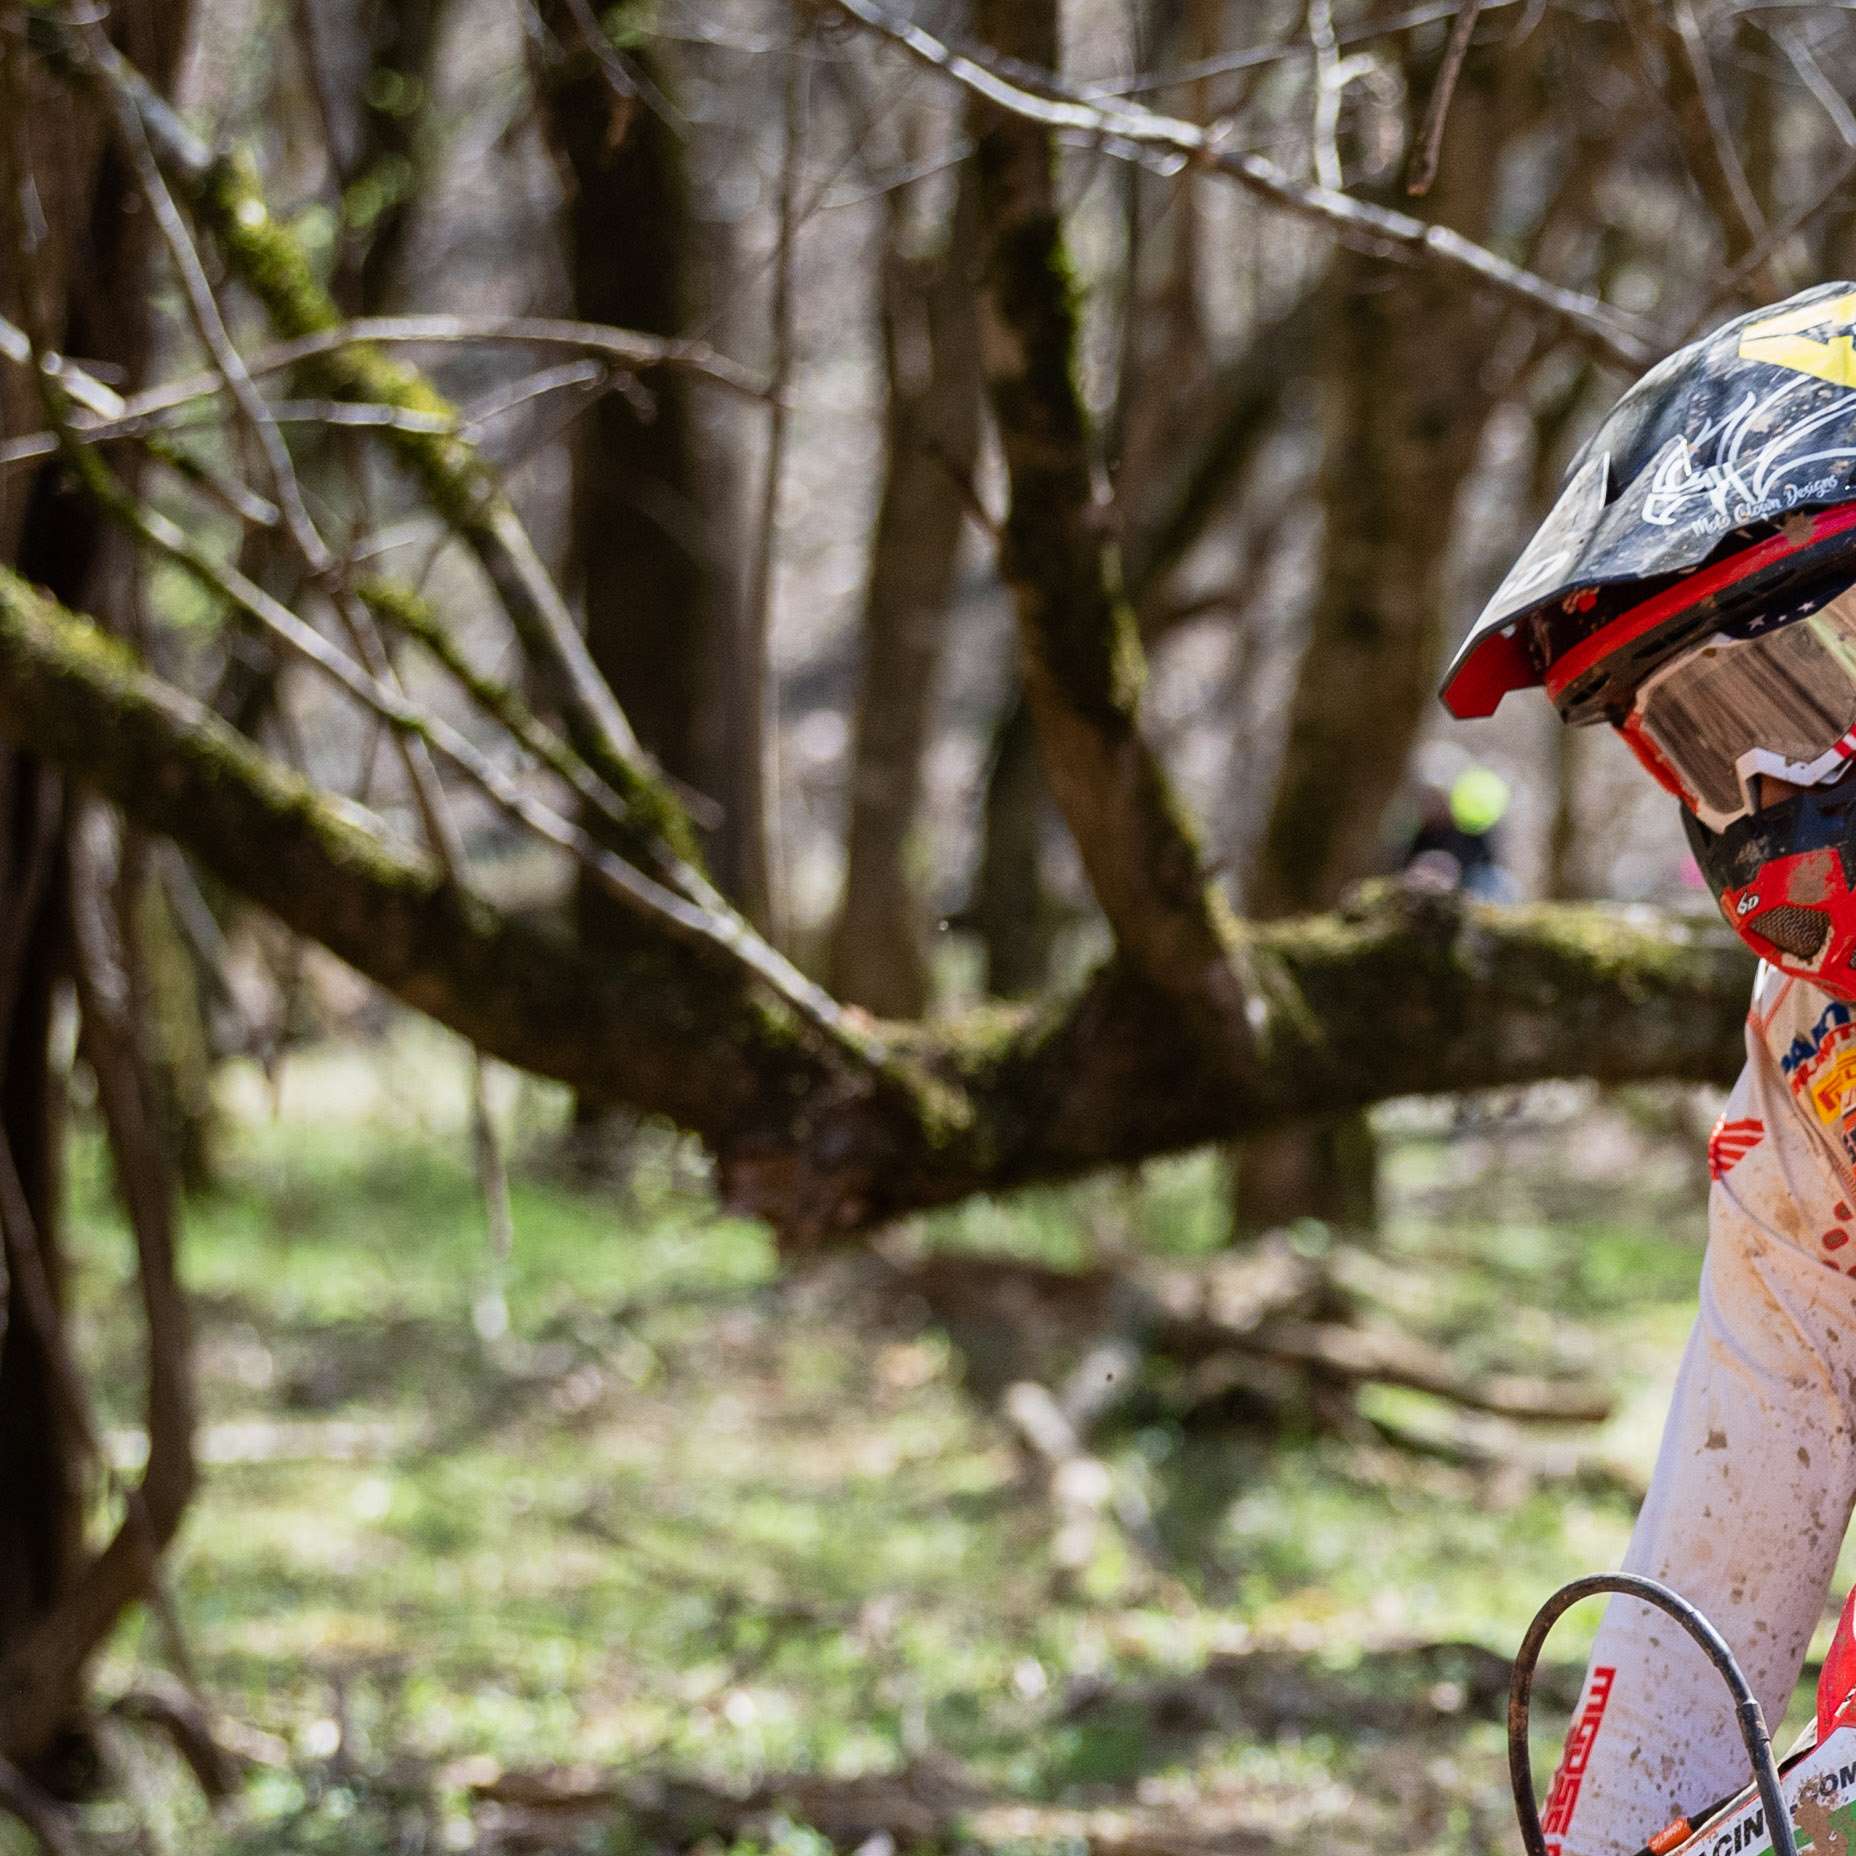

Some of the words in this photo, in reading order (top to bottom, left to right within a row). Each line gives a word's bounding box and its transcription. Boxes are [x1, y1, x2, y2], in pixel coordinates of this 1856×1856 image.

[1691, 509, 1731, 538] Moto
[1733, 495, 1782, 523] Clown
[1783, 474, 1838, 502] Designs
